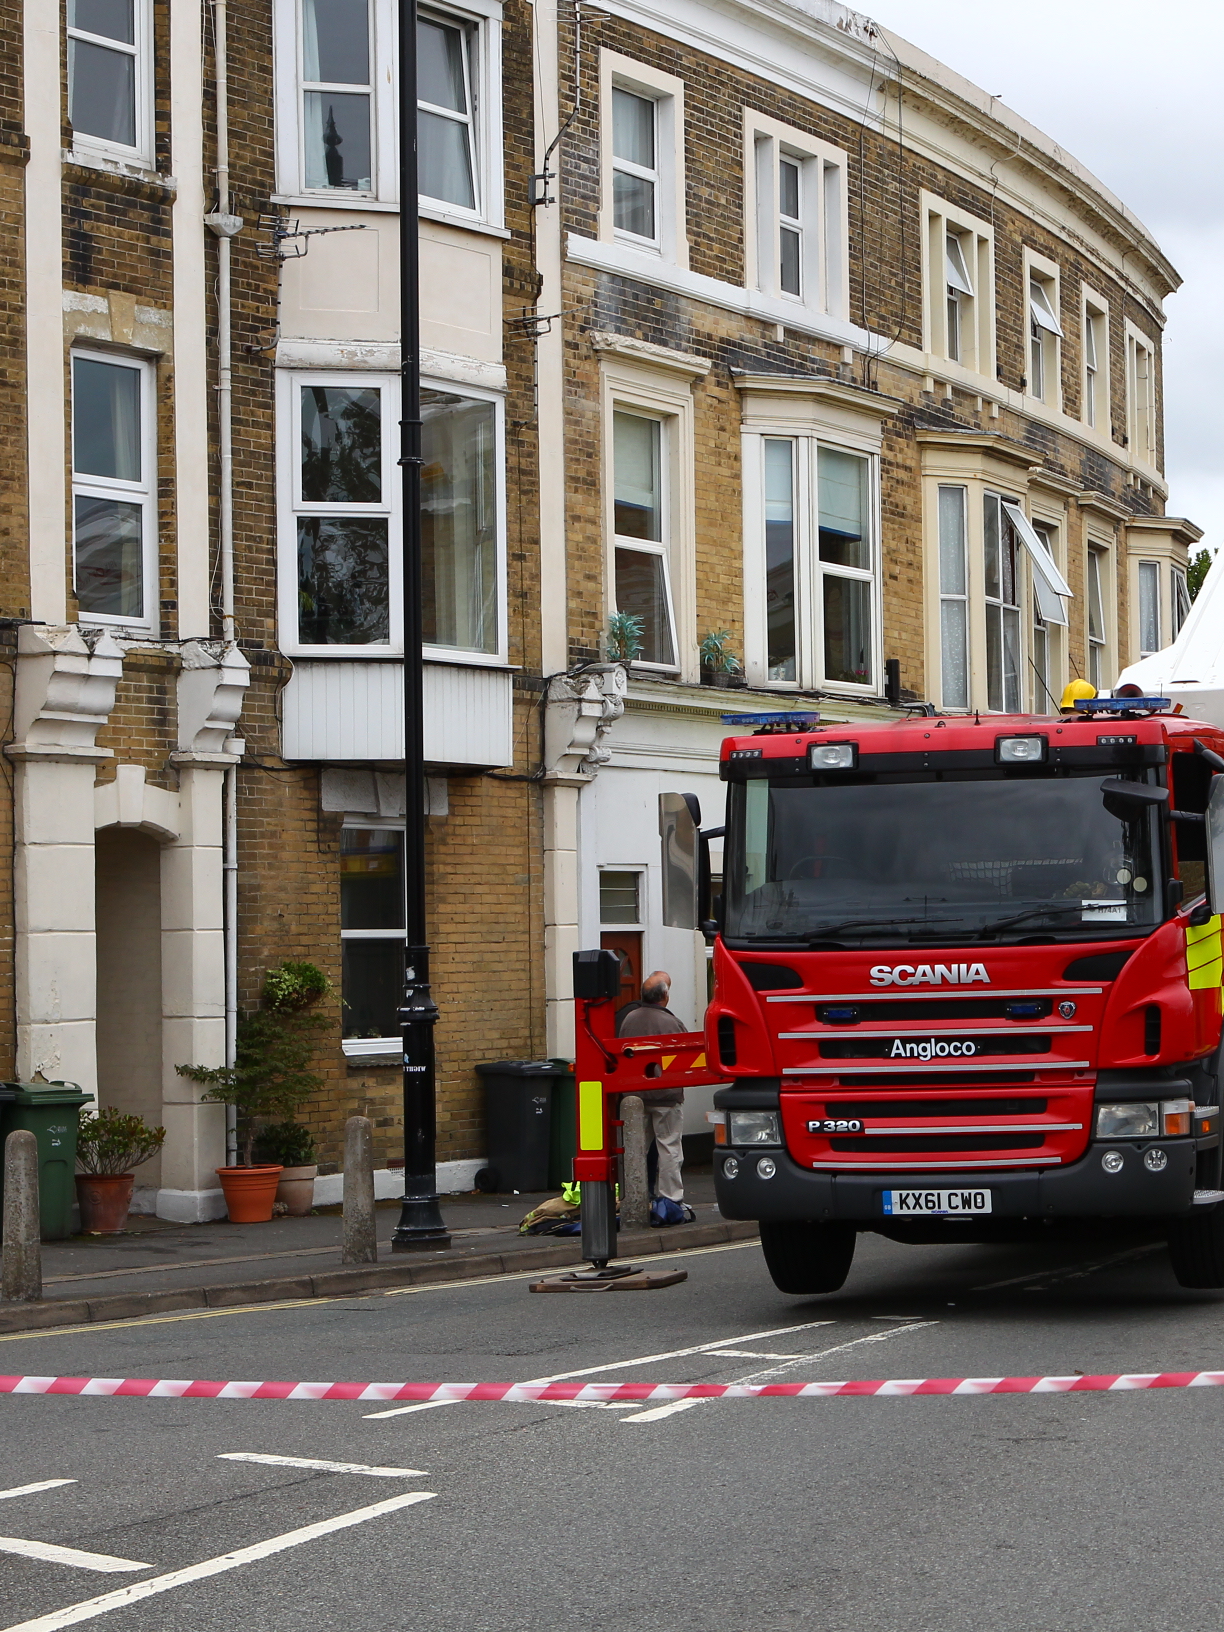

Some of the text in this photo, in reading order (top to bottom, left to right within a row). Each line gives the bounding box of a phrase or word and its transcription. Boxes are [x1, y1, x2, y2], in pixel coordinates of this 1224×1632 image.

[869, 963, 991, 987] SCANIA
[890, 1038, 976, 1061] Angloco
[808, 1120, 860, 1132] P 320
[899, 1191, 985, 1211] KX61 CWO
